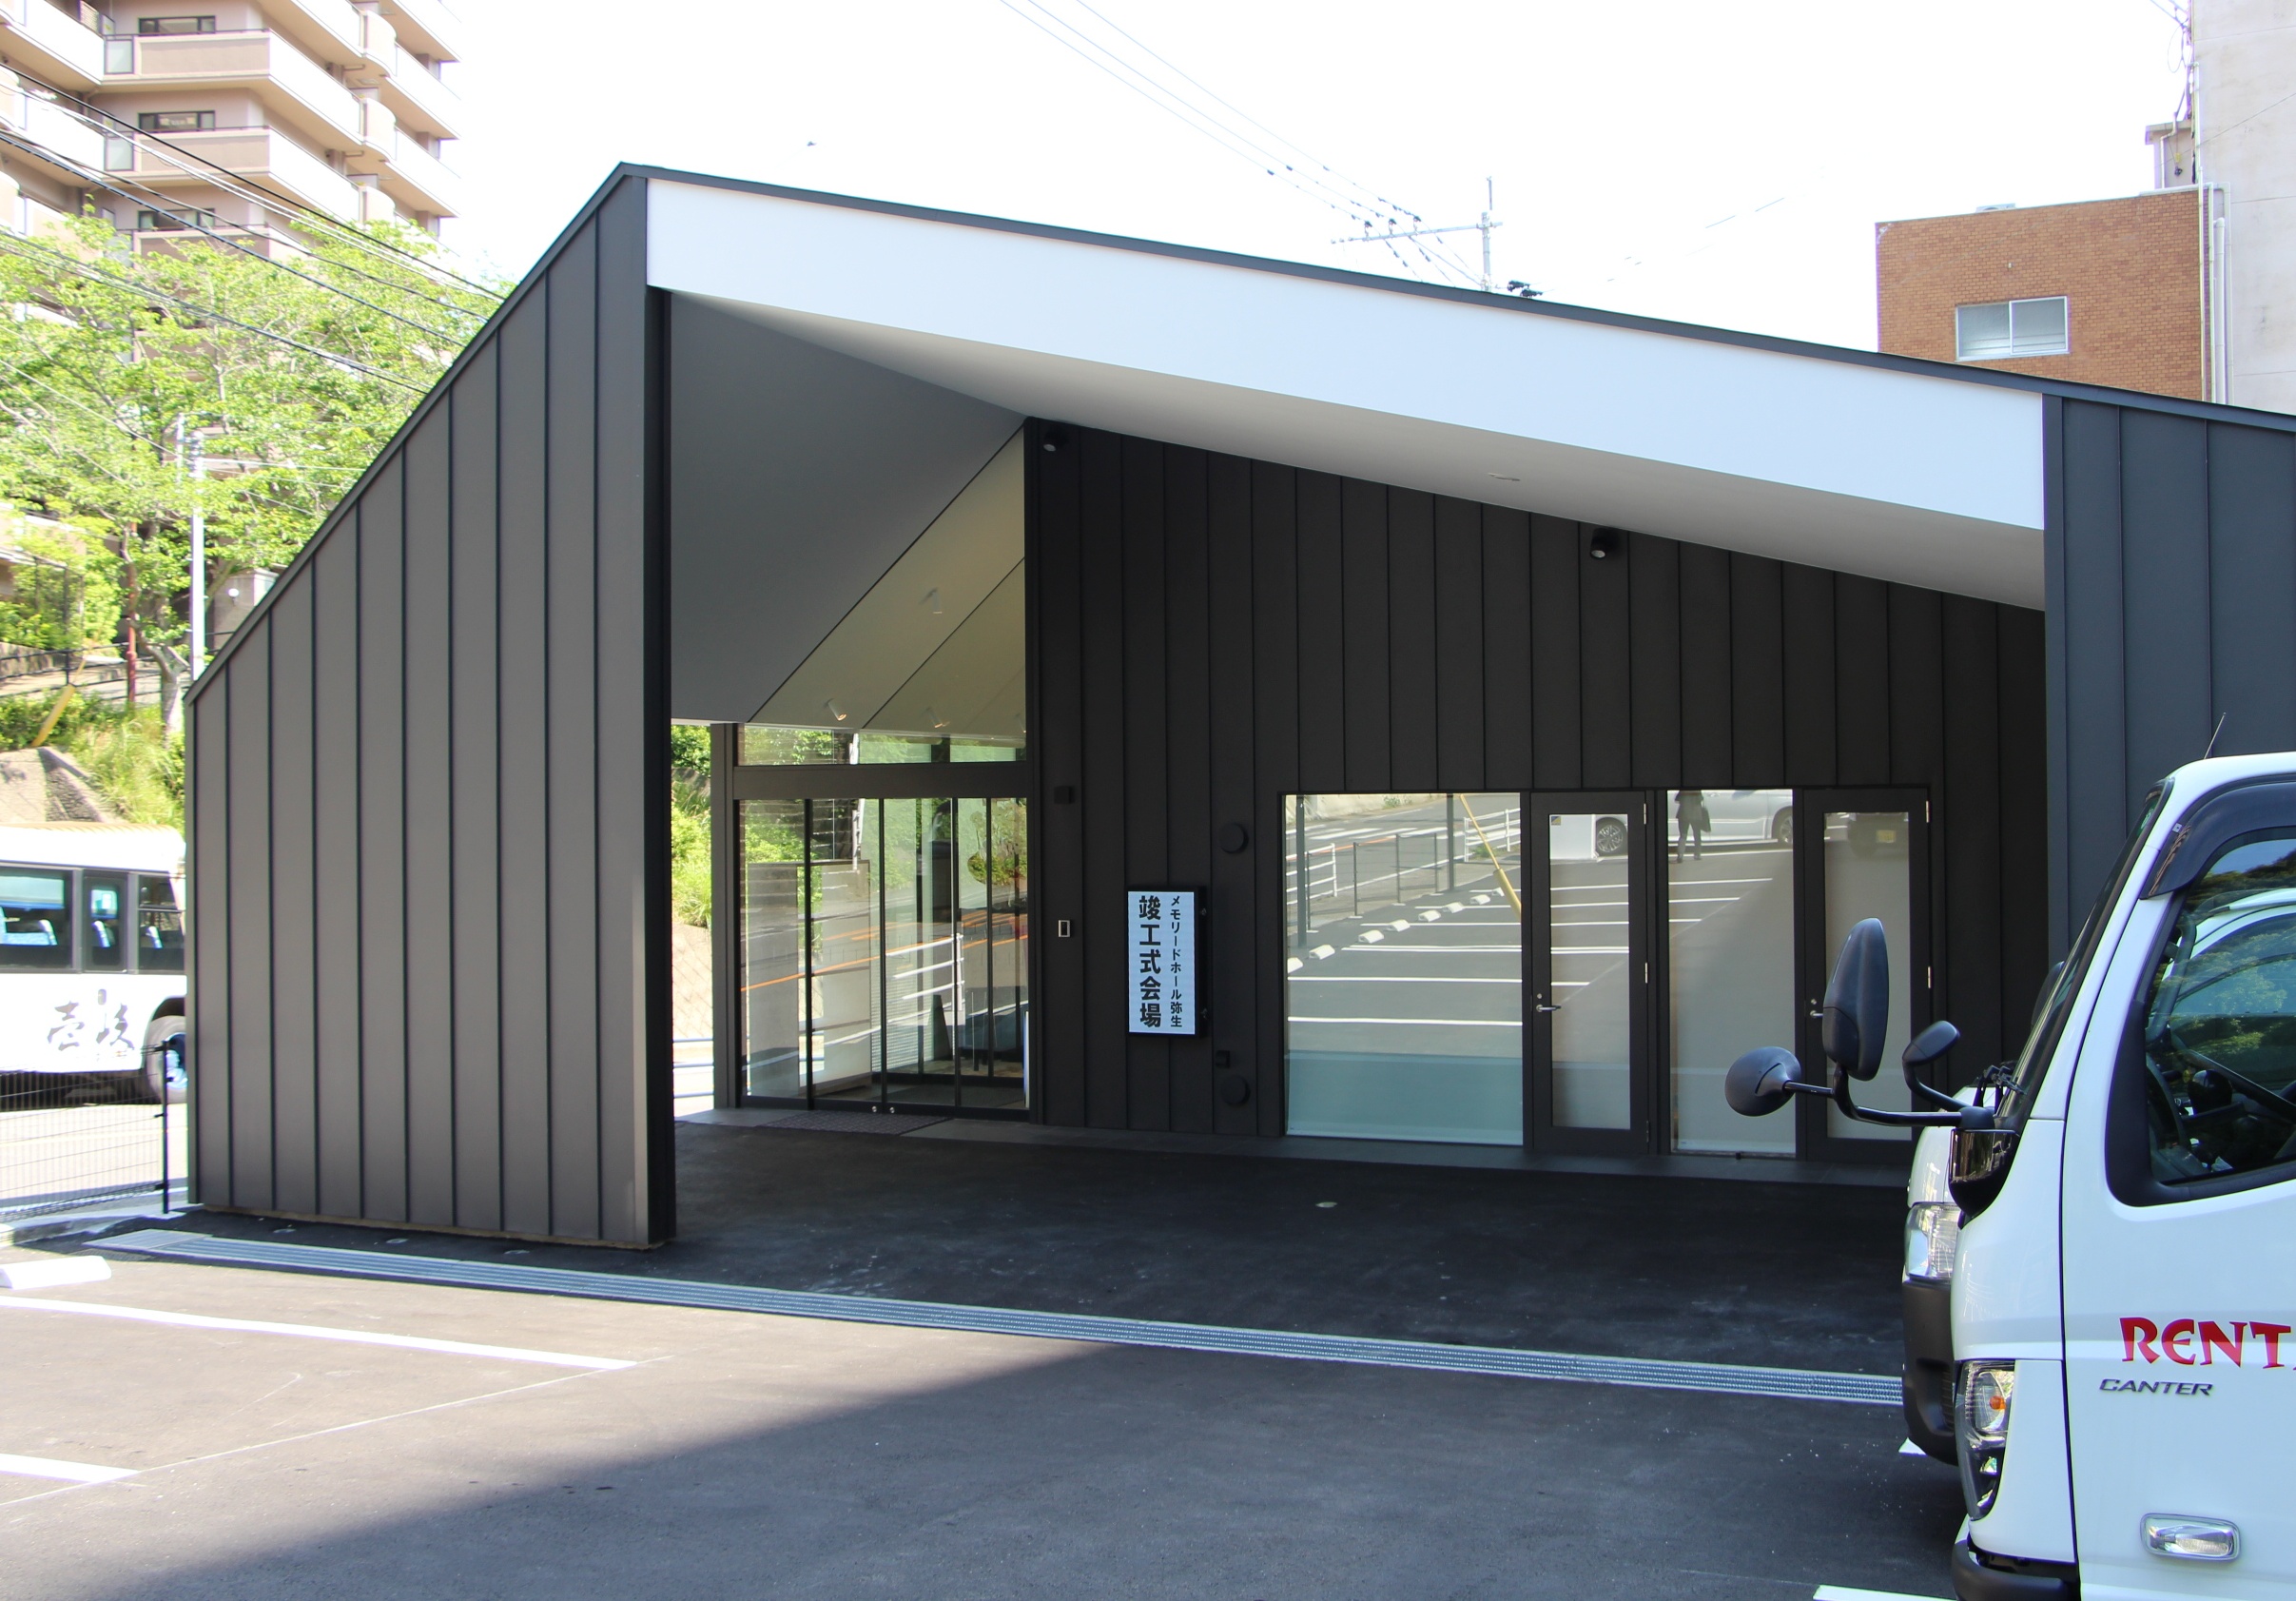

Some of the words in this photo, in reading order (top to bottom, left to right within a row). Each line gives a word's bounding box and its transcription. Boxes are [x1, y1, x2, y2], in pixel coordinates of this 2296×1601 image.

[1138, 895, 1161, 1027] 竣工式会場
[1170, 895, 1182, 1027] メモリードホール弥生
[2098, 1378, 2213, 1396] CANTER
[2119, 1317, 2296, 1370] RENT
